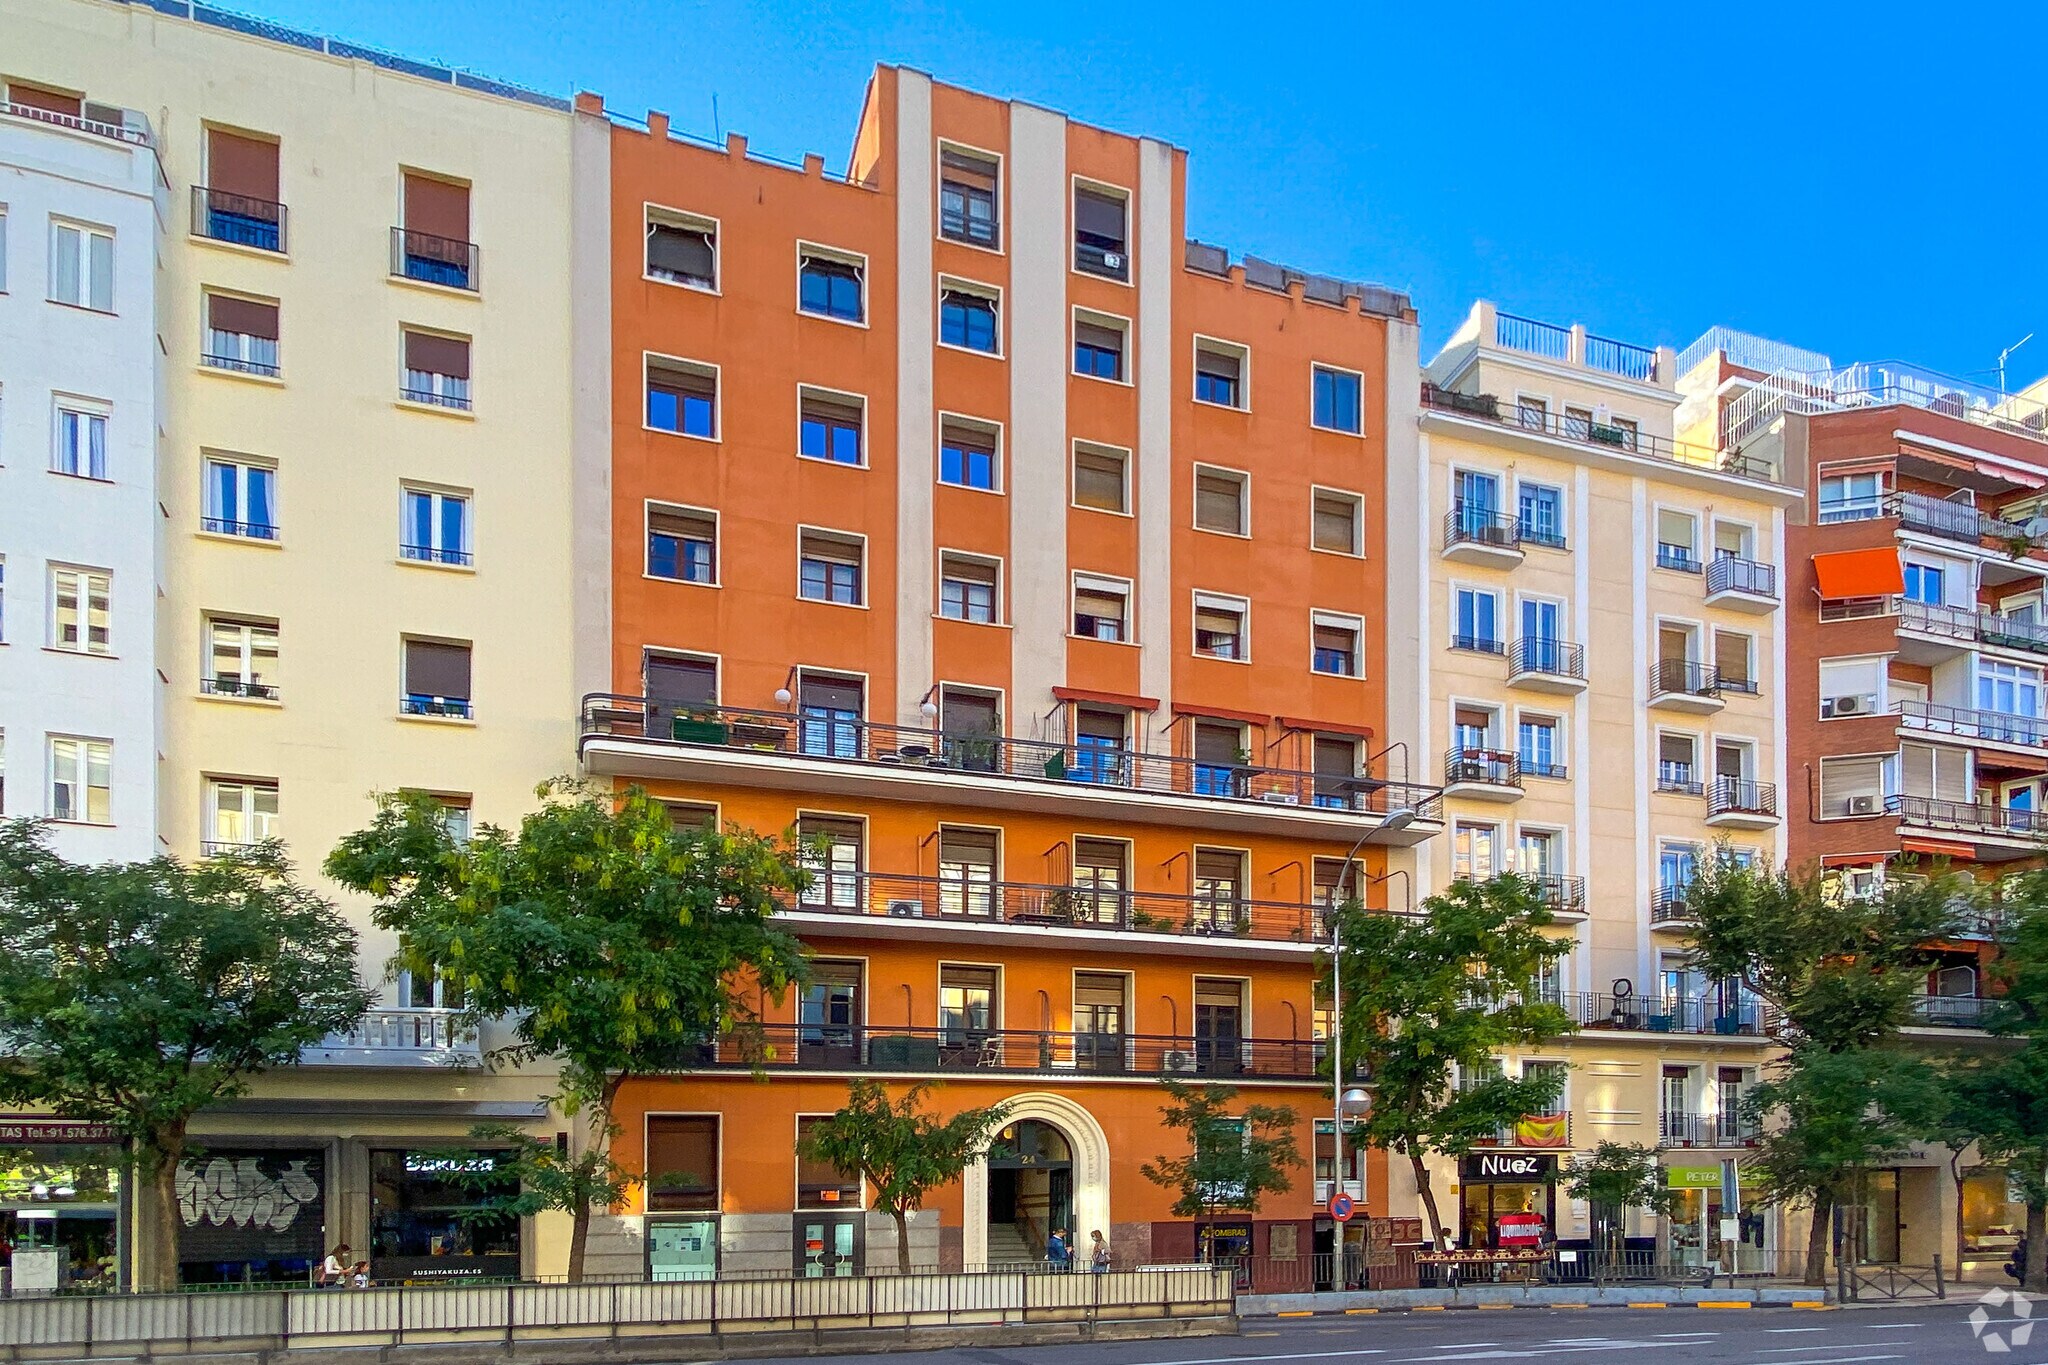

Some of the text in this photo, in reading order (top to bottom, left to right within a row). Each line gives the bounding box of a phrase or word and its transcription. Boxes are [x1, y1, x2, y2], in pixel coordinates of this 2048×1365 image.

[1021, 1155, 1036, 1164] 24
[1481, 1155, 1538, 1175] Nuez
[1686, 1171, 1719, 1181] PETER
